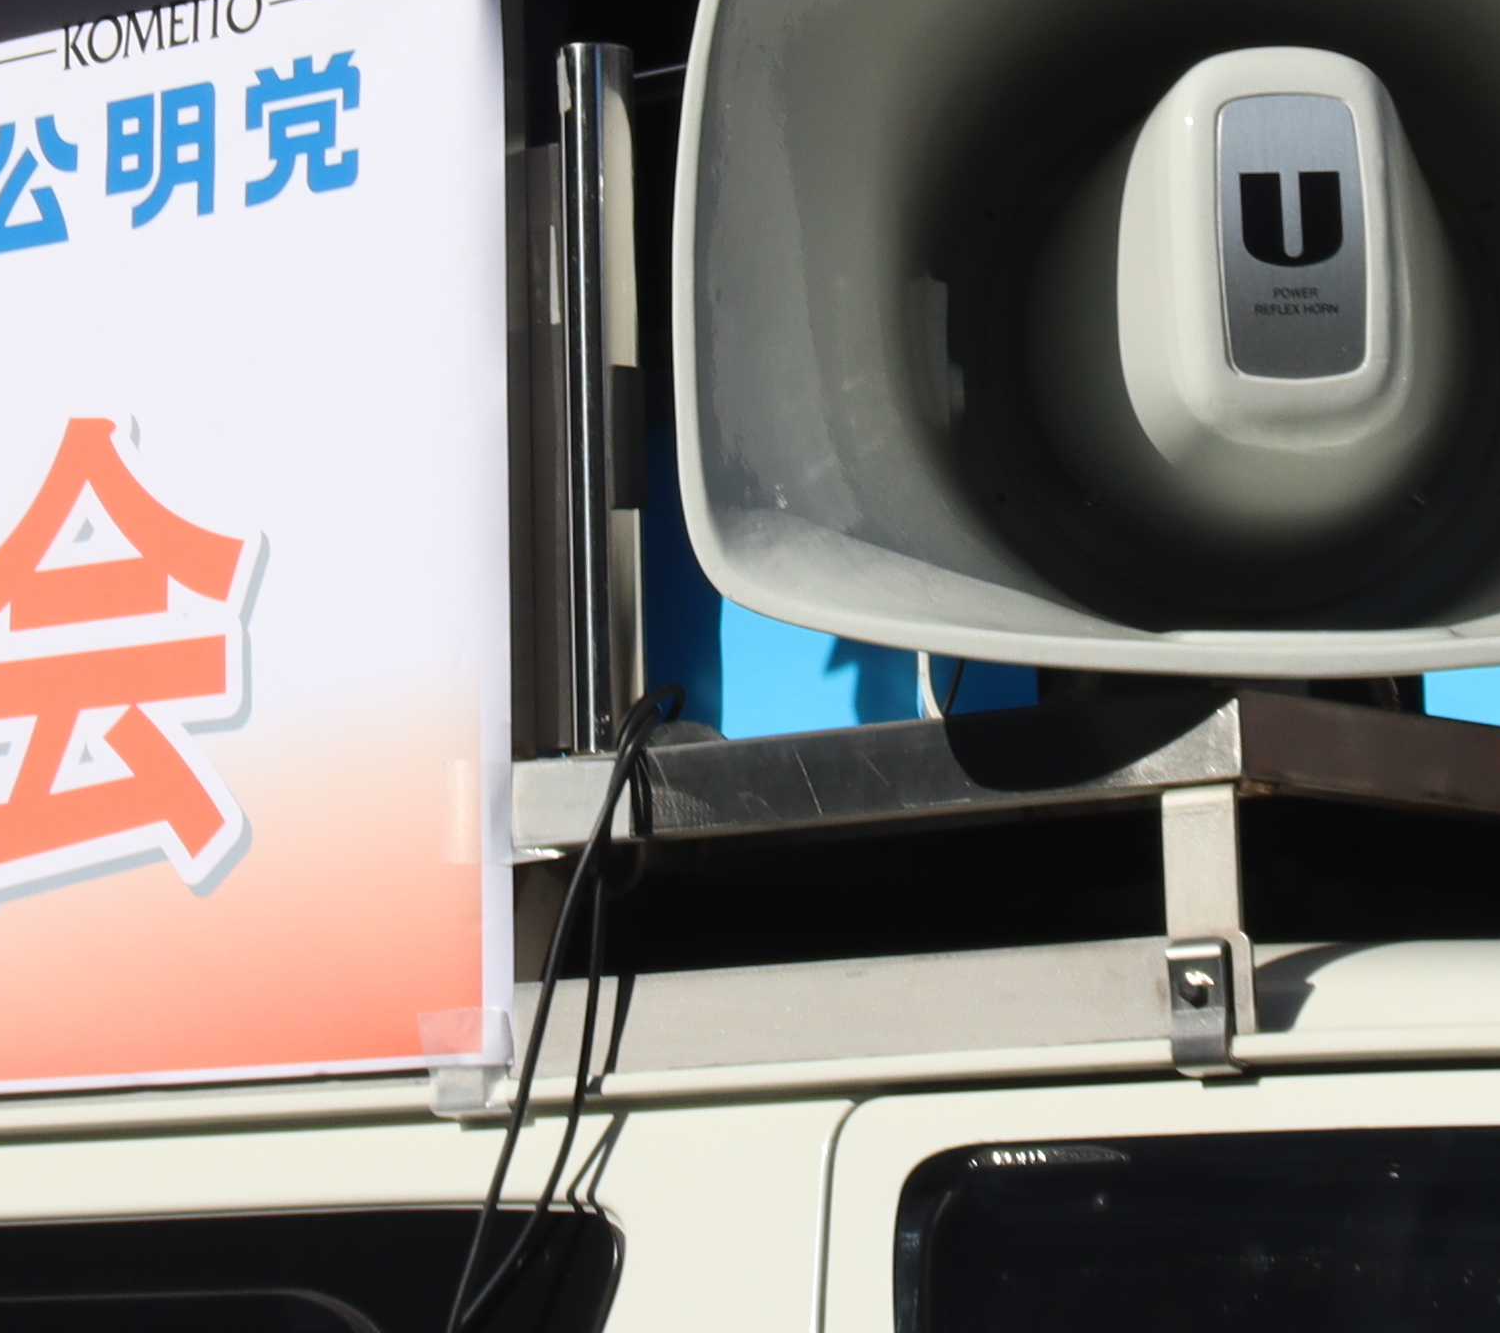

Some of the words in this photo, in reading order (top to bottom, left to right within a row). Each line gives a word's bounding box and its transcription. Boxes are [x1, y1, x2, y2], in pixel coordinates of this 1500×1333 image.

[1273, 287, 1319, 299] POWER
[1254, 303, 1301, 315] REFLEX
[1303, 303, 1340, 315] HORN
